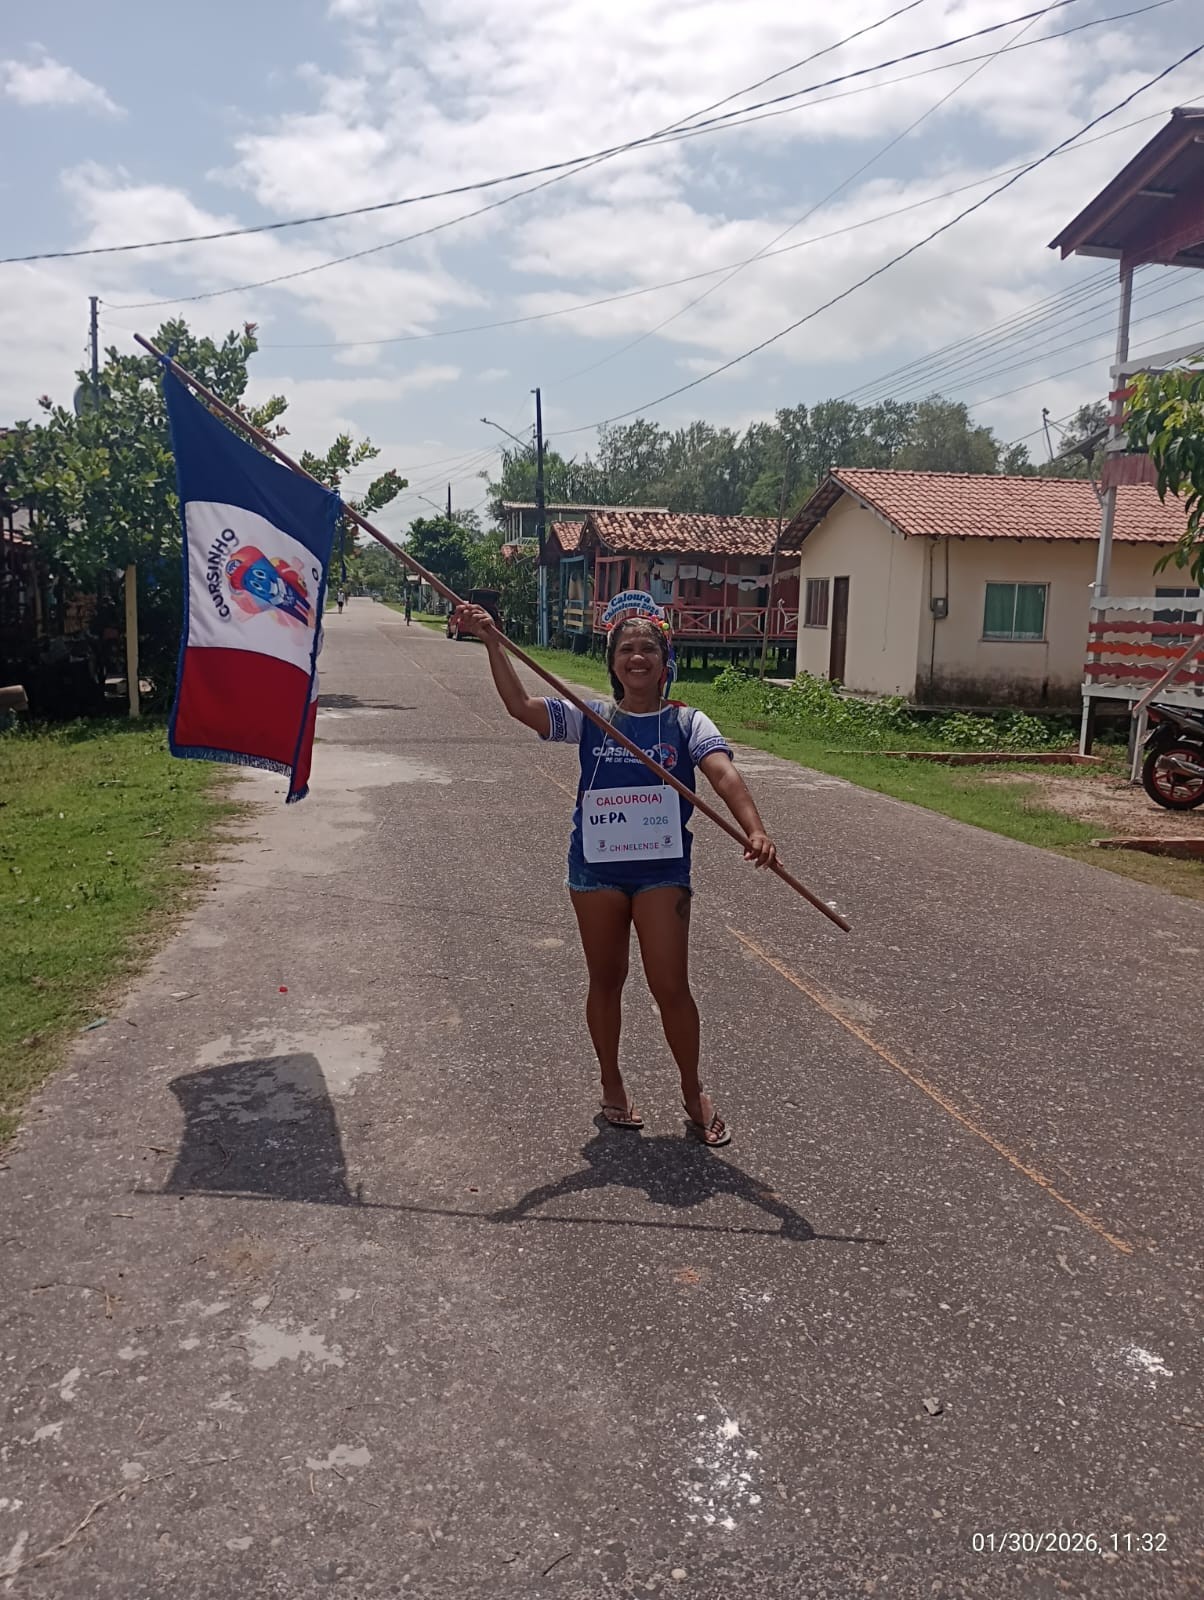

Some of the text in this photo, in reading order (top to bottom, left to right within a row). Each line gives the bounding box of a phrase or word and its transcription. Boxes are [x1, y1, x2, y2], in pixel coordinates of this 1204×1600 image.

[207, 528, 236, 618] CURSINHO
[611, 593, 651, 607] Caloura
[596, 794, 662, 806] CALOURO(A)
[590, 812, 669, 825] UEPA 2026
[609, 842, 660, 852] CHINELENSE
